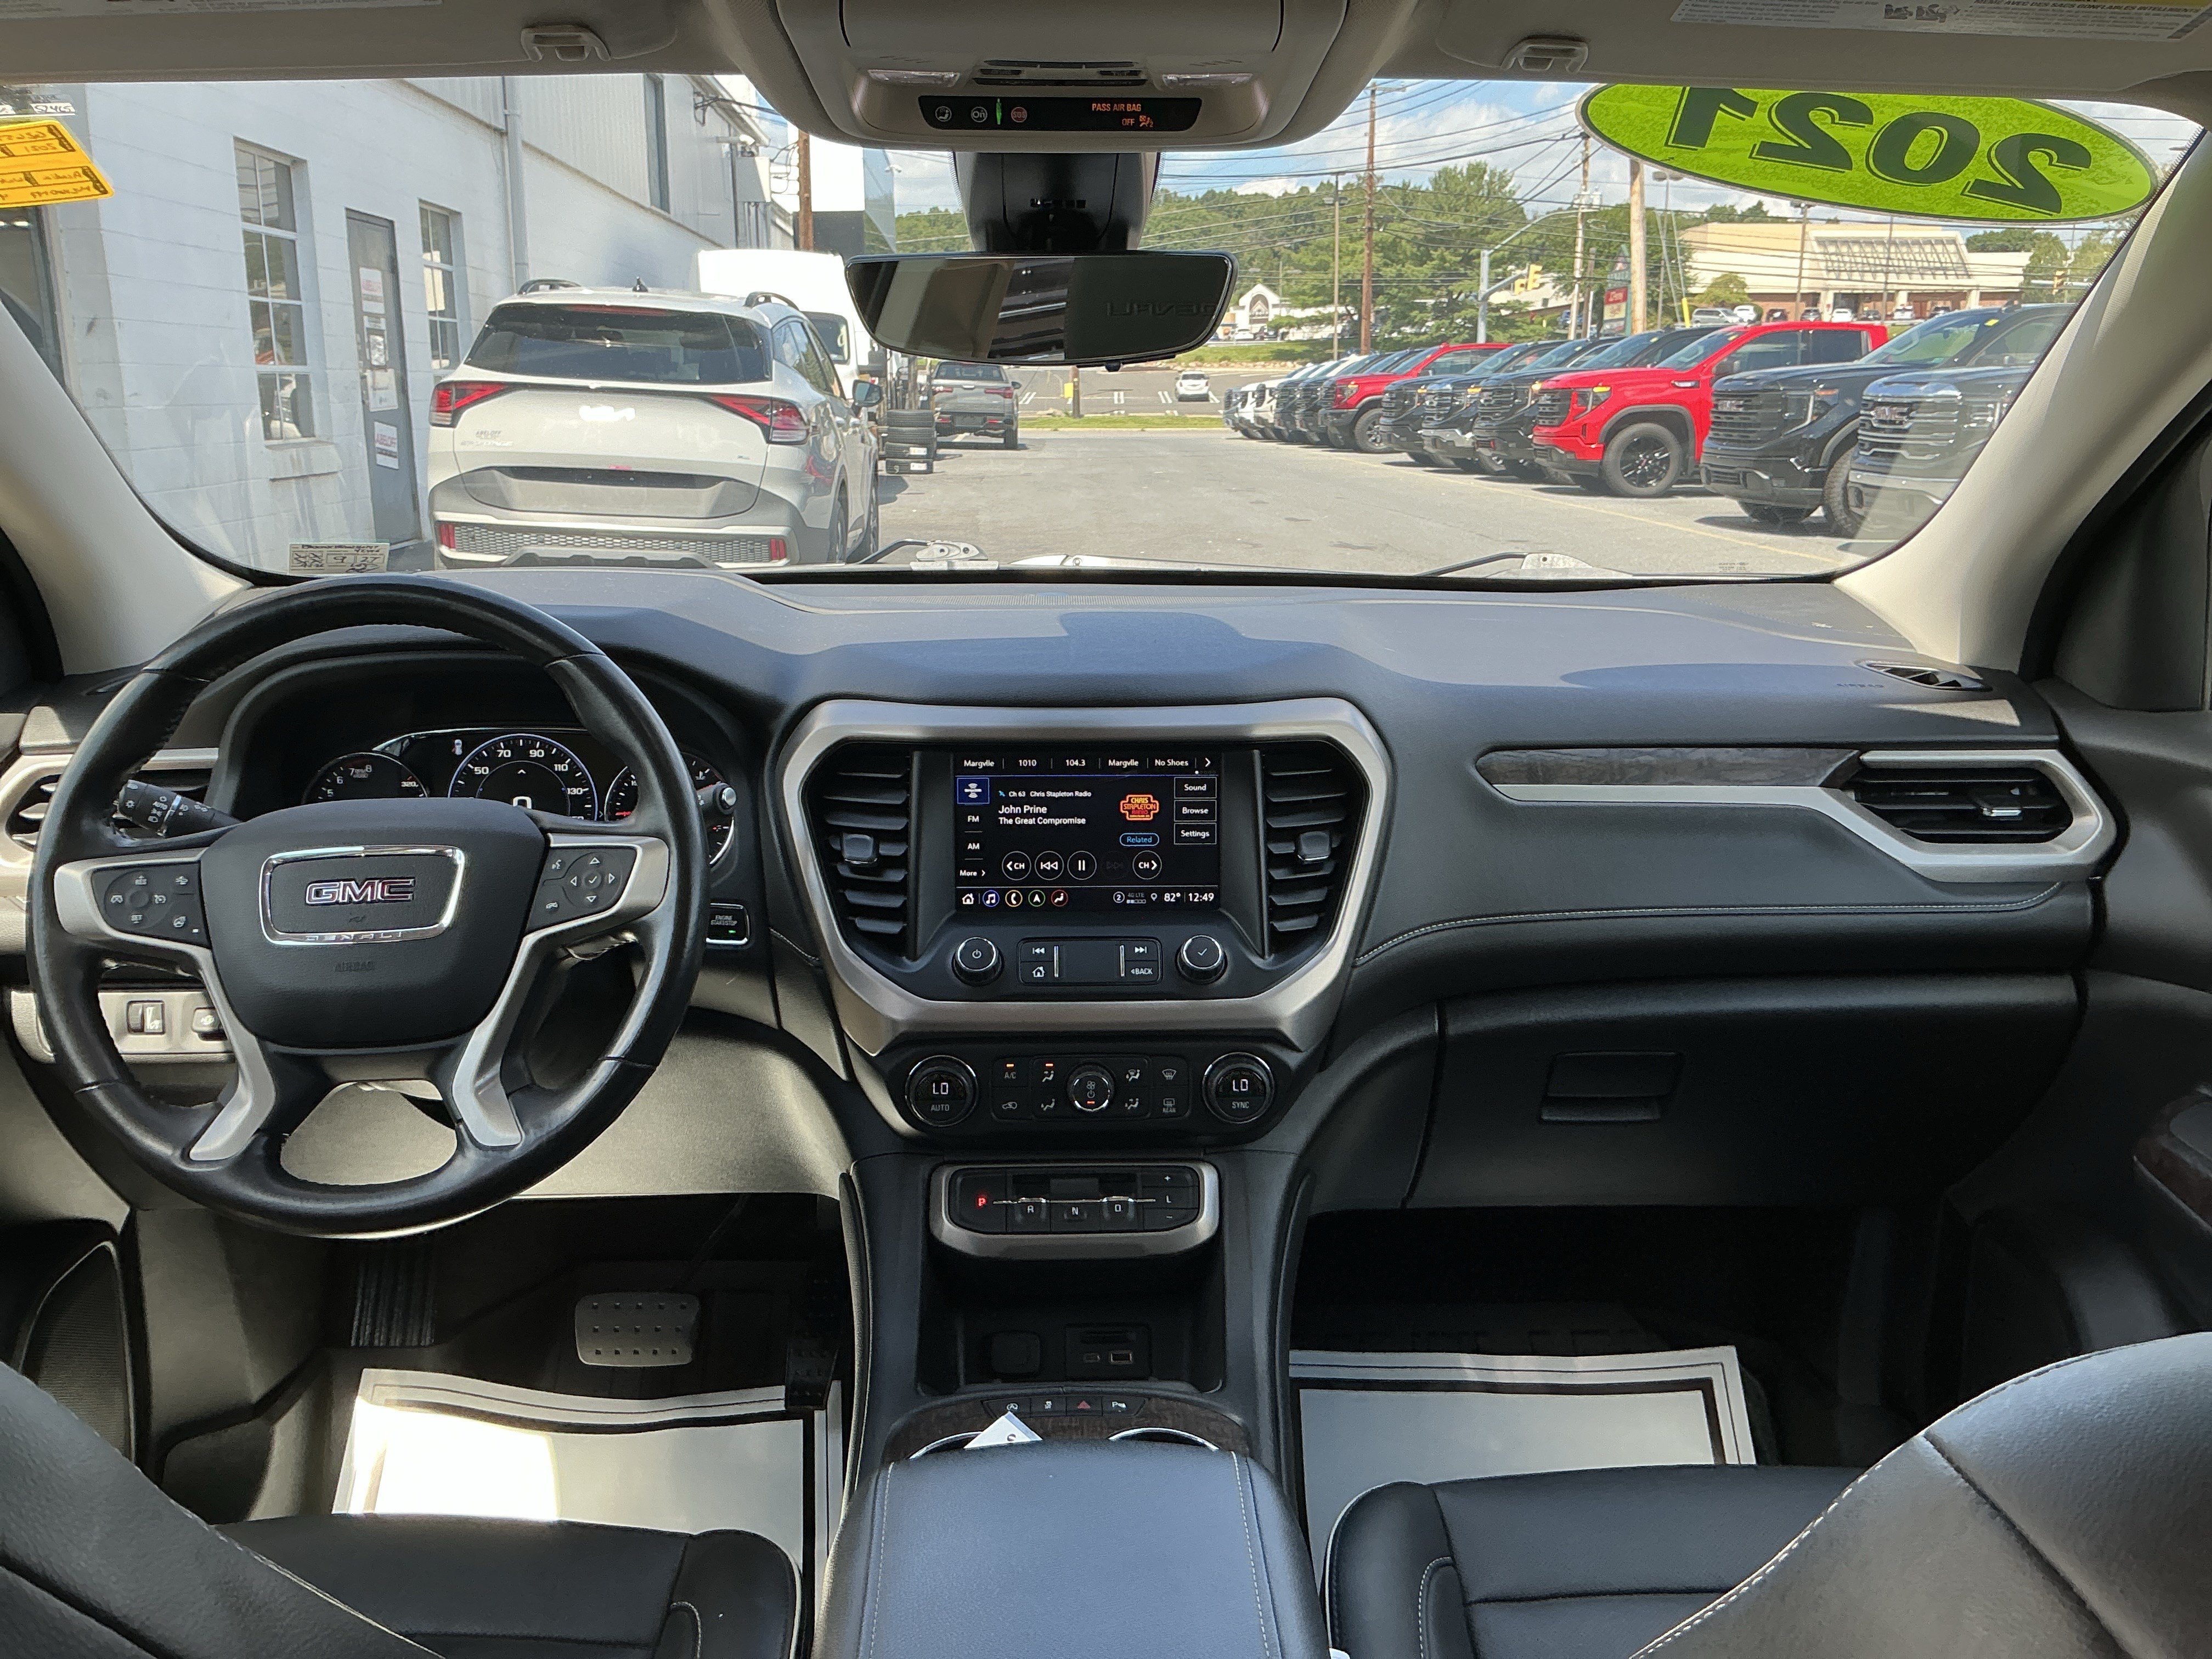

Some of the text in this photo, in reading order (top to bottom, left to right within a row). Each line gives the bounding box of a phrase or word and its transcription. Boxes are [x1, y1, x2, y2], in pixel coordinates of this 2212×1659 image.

[1092, 103, 1141, 111] PASS AIR BAG
[497, 749, 511, 758] 70
[474, 766, 489, 775] 50
[554, 763, 568, 771] 110
[327, 789, 333, 797] 5
[567, 787, 583, 795] 130
[998, 805, 1047, 814] John Prine
[1037, 817, 1086, 826] Compromise
[1181, 830, 1210, 838] Settings
[305, 877, 415, 906] GMC
[1188, 893, 1215, 901] 12:49
[306, 932, 402, 941] DENALI
[1134, 967, 1153, 975] BACK
[933, 1082, 949, 1095] LO
[1232, 1079, 1248, 1092] LO
[978, 1198, 986, 1206] P
[1028, 1205, 1034, 1213] R
[1071, 1206, 1079, 1215] N
